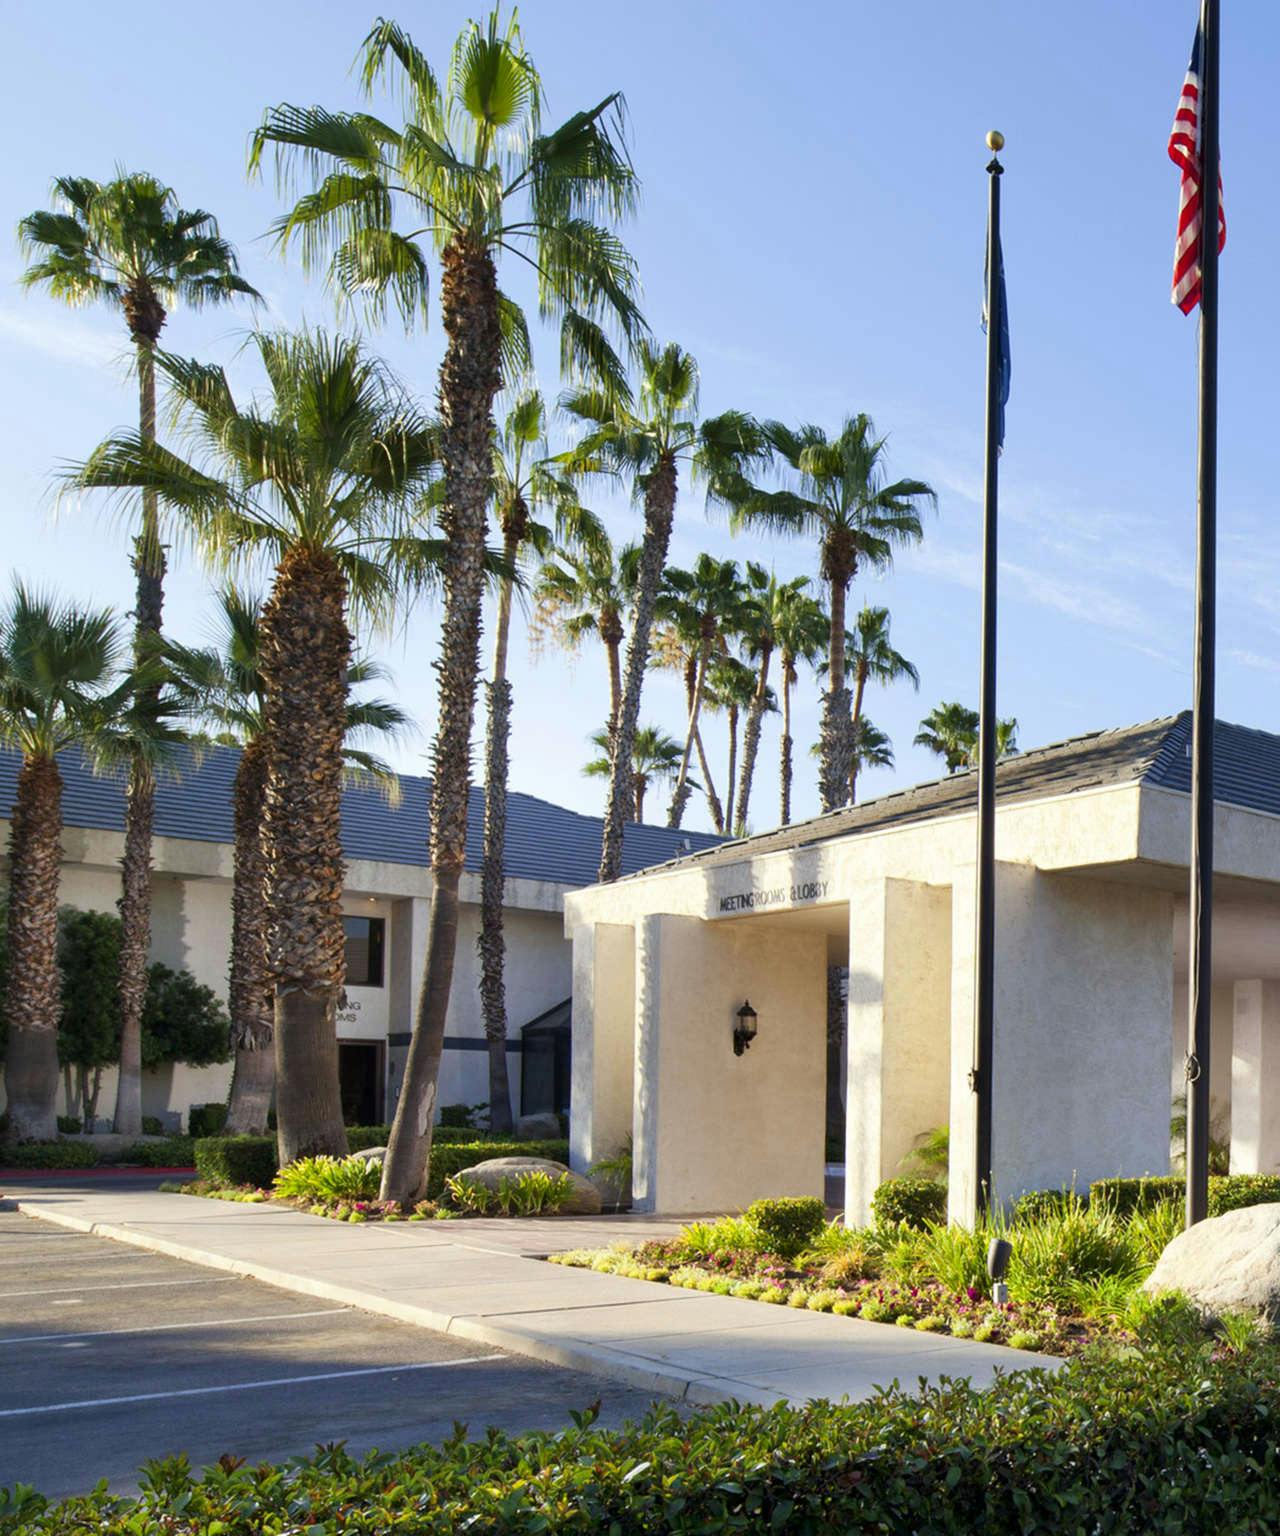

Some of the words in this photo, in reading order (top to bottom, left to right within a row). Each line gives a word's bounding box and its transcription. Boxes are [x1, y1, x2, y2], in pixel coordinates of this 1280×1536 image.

[720, 892, 753, 912] MEETING
[753, 888, 785, 906] ROOMS
[797, 881, 829, 900] LOBBY
